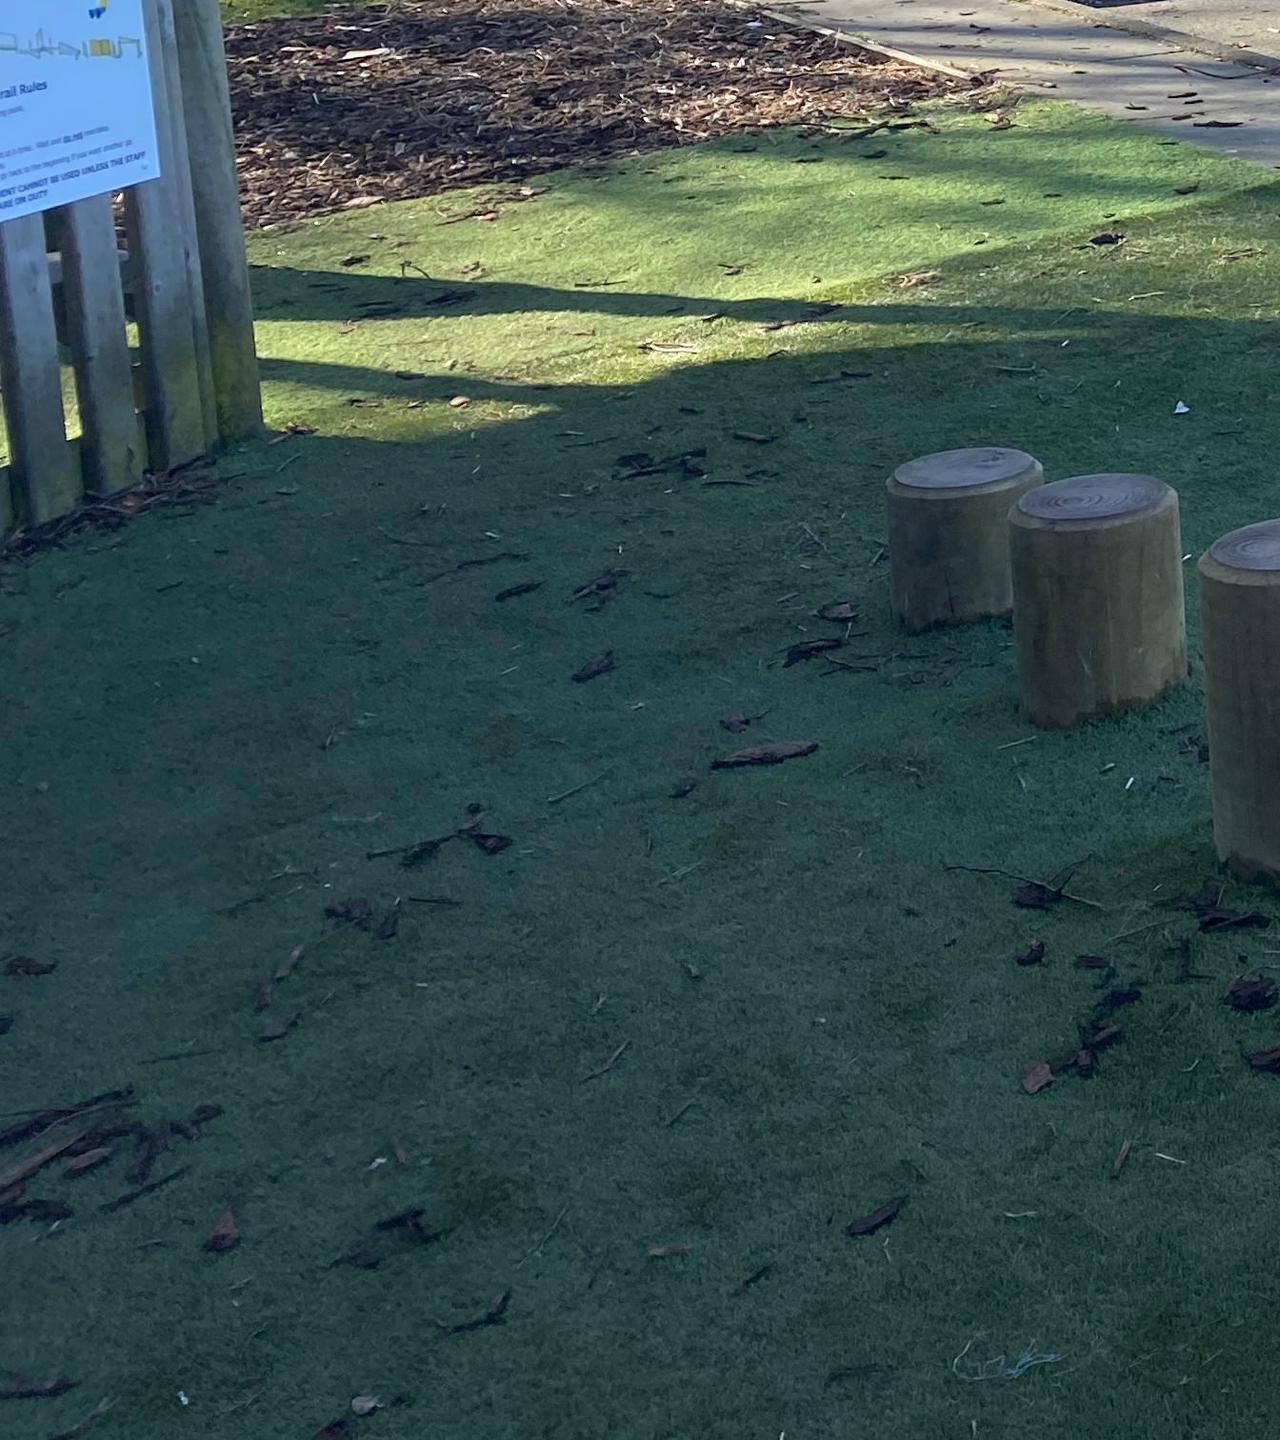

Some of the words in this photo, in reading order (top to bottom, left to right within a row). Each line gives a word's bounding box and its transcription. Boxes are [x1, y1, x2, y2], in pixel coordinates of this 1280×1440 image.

[19, 80, 48, 96] Rules
[17, 177, 48, 193] CANNOT
[60, 169, 81, 181] USED
[81, 161, 110, 176] UNLESS
[109, 157, 124, 168] THE
[124, 150, 146, 164] STAFF
[27, 189, 48, 202] DUTY
